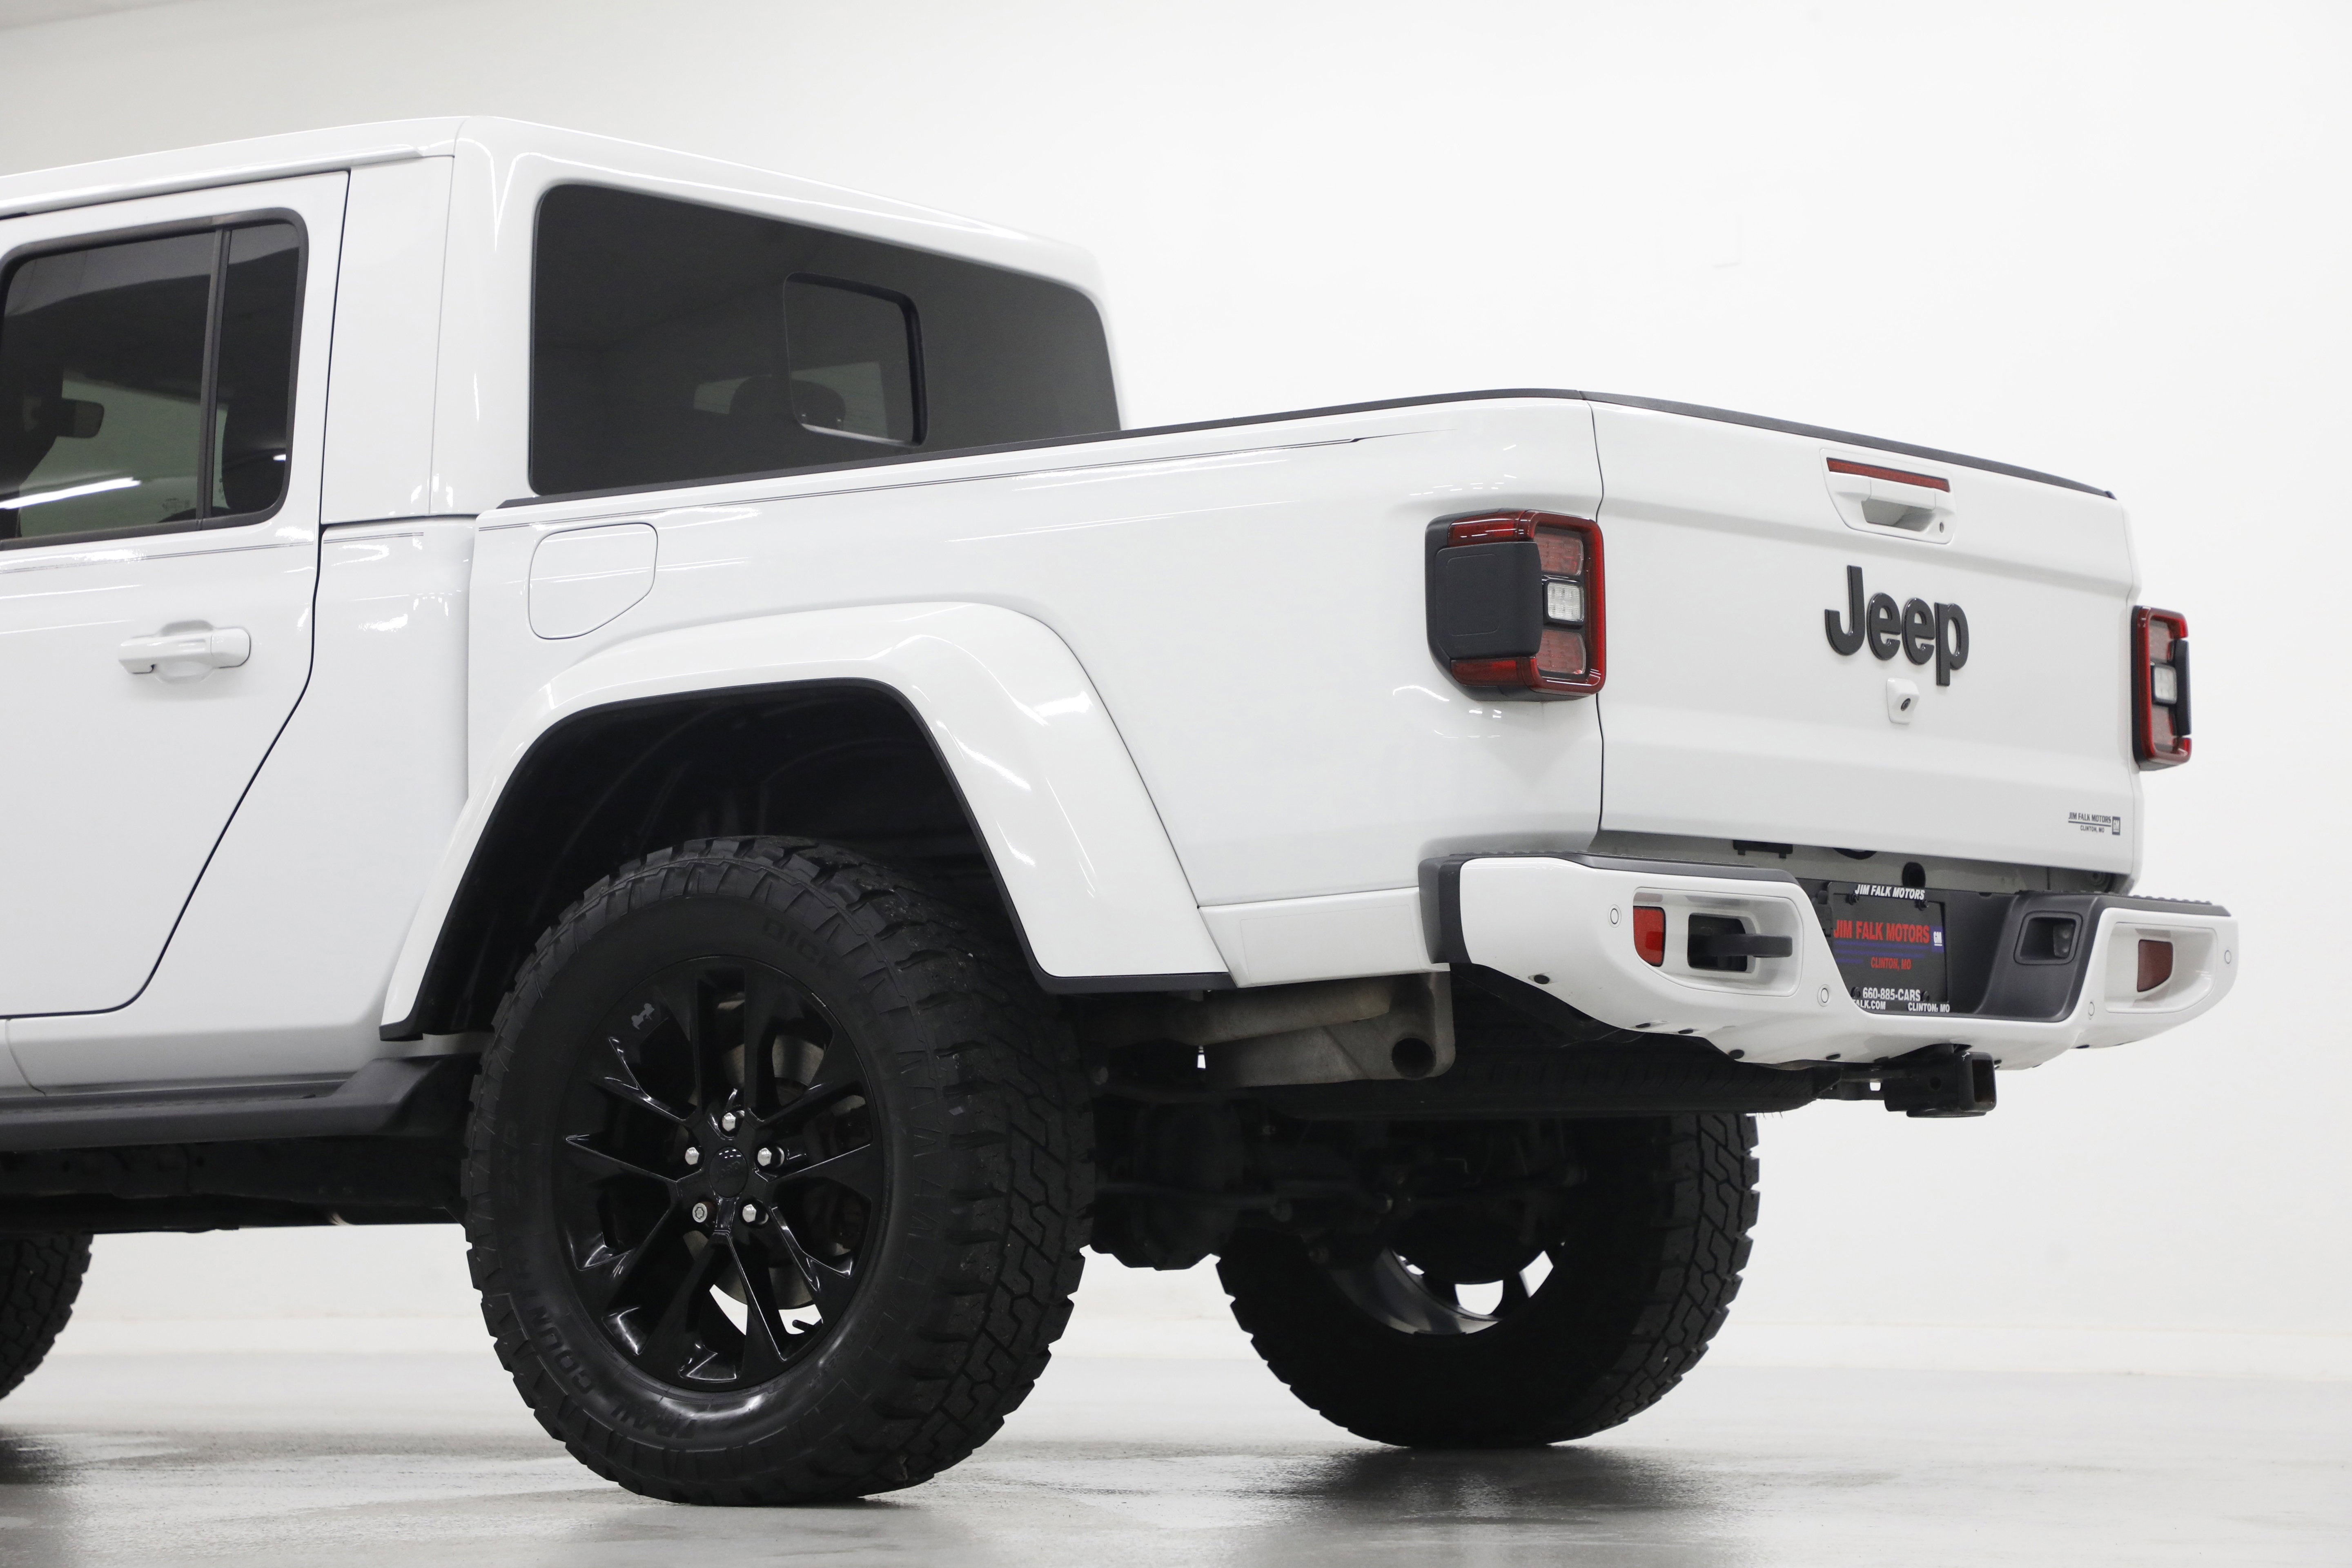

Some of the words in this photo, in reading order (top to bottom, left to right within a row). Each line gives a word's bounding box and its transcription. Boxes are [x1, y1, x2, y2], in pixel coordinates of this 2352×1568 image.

[1824, 565, 1969, 686] Jeep
[2078, 813, 2090, 821] FALK
[2091, 815, 2111, 823] MOTORS
[1855, 884, 1869, 895] JIM
[1871, 885, 1892, 897] FALK
[1892, 887, 1925, 900] MOTORS
[1834, 920, 1852, 938] JIM
[1856, 921, 1884, 940] FALK
[1886, 923, 1930, 943] MOTORS
[1933, 931, 1942, 944] GM
[1871, 957, 1900, 971] CLINTON,
[1901, 959, 1911, 970] MO
[1863, 987, 1921, 1002] 660-885-CARS
[1908, 1002, 1938, 1012] CLINTON,
[1940, 1004, 1950, 1013] MO
